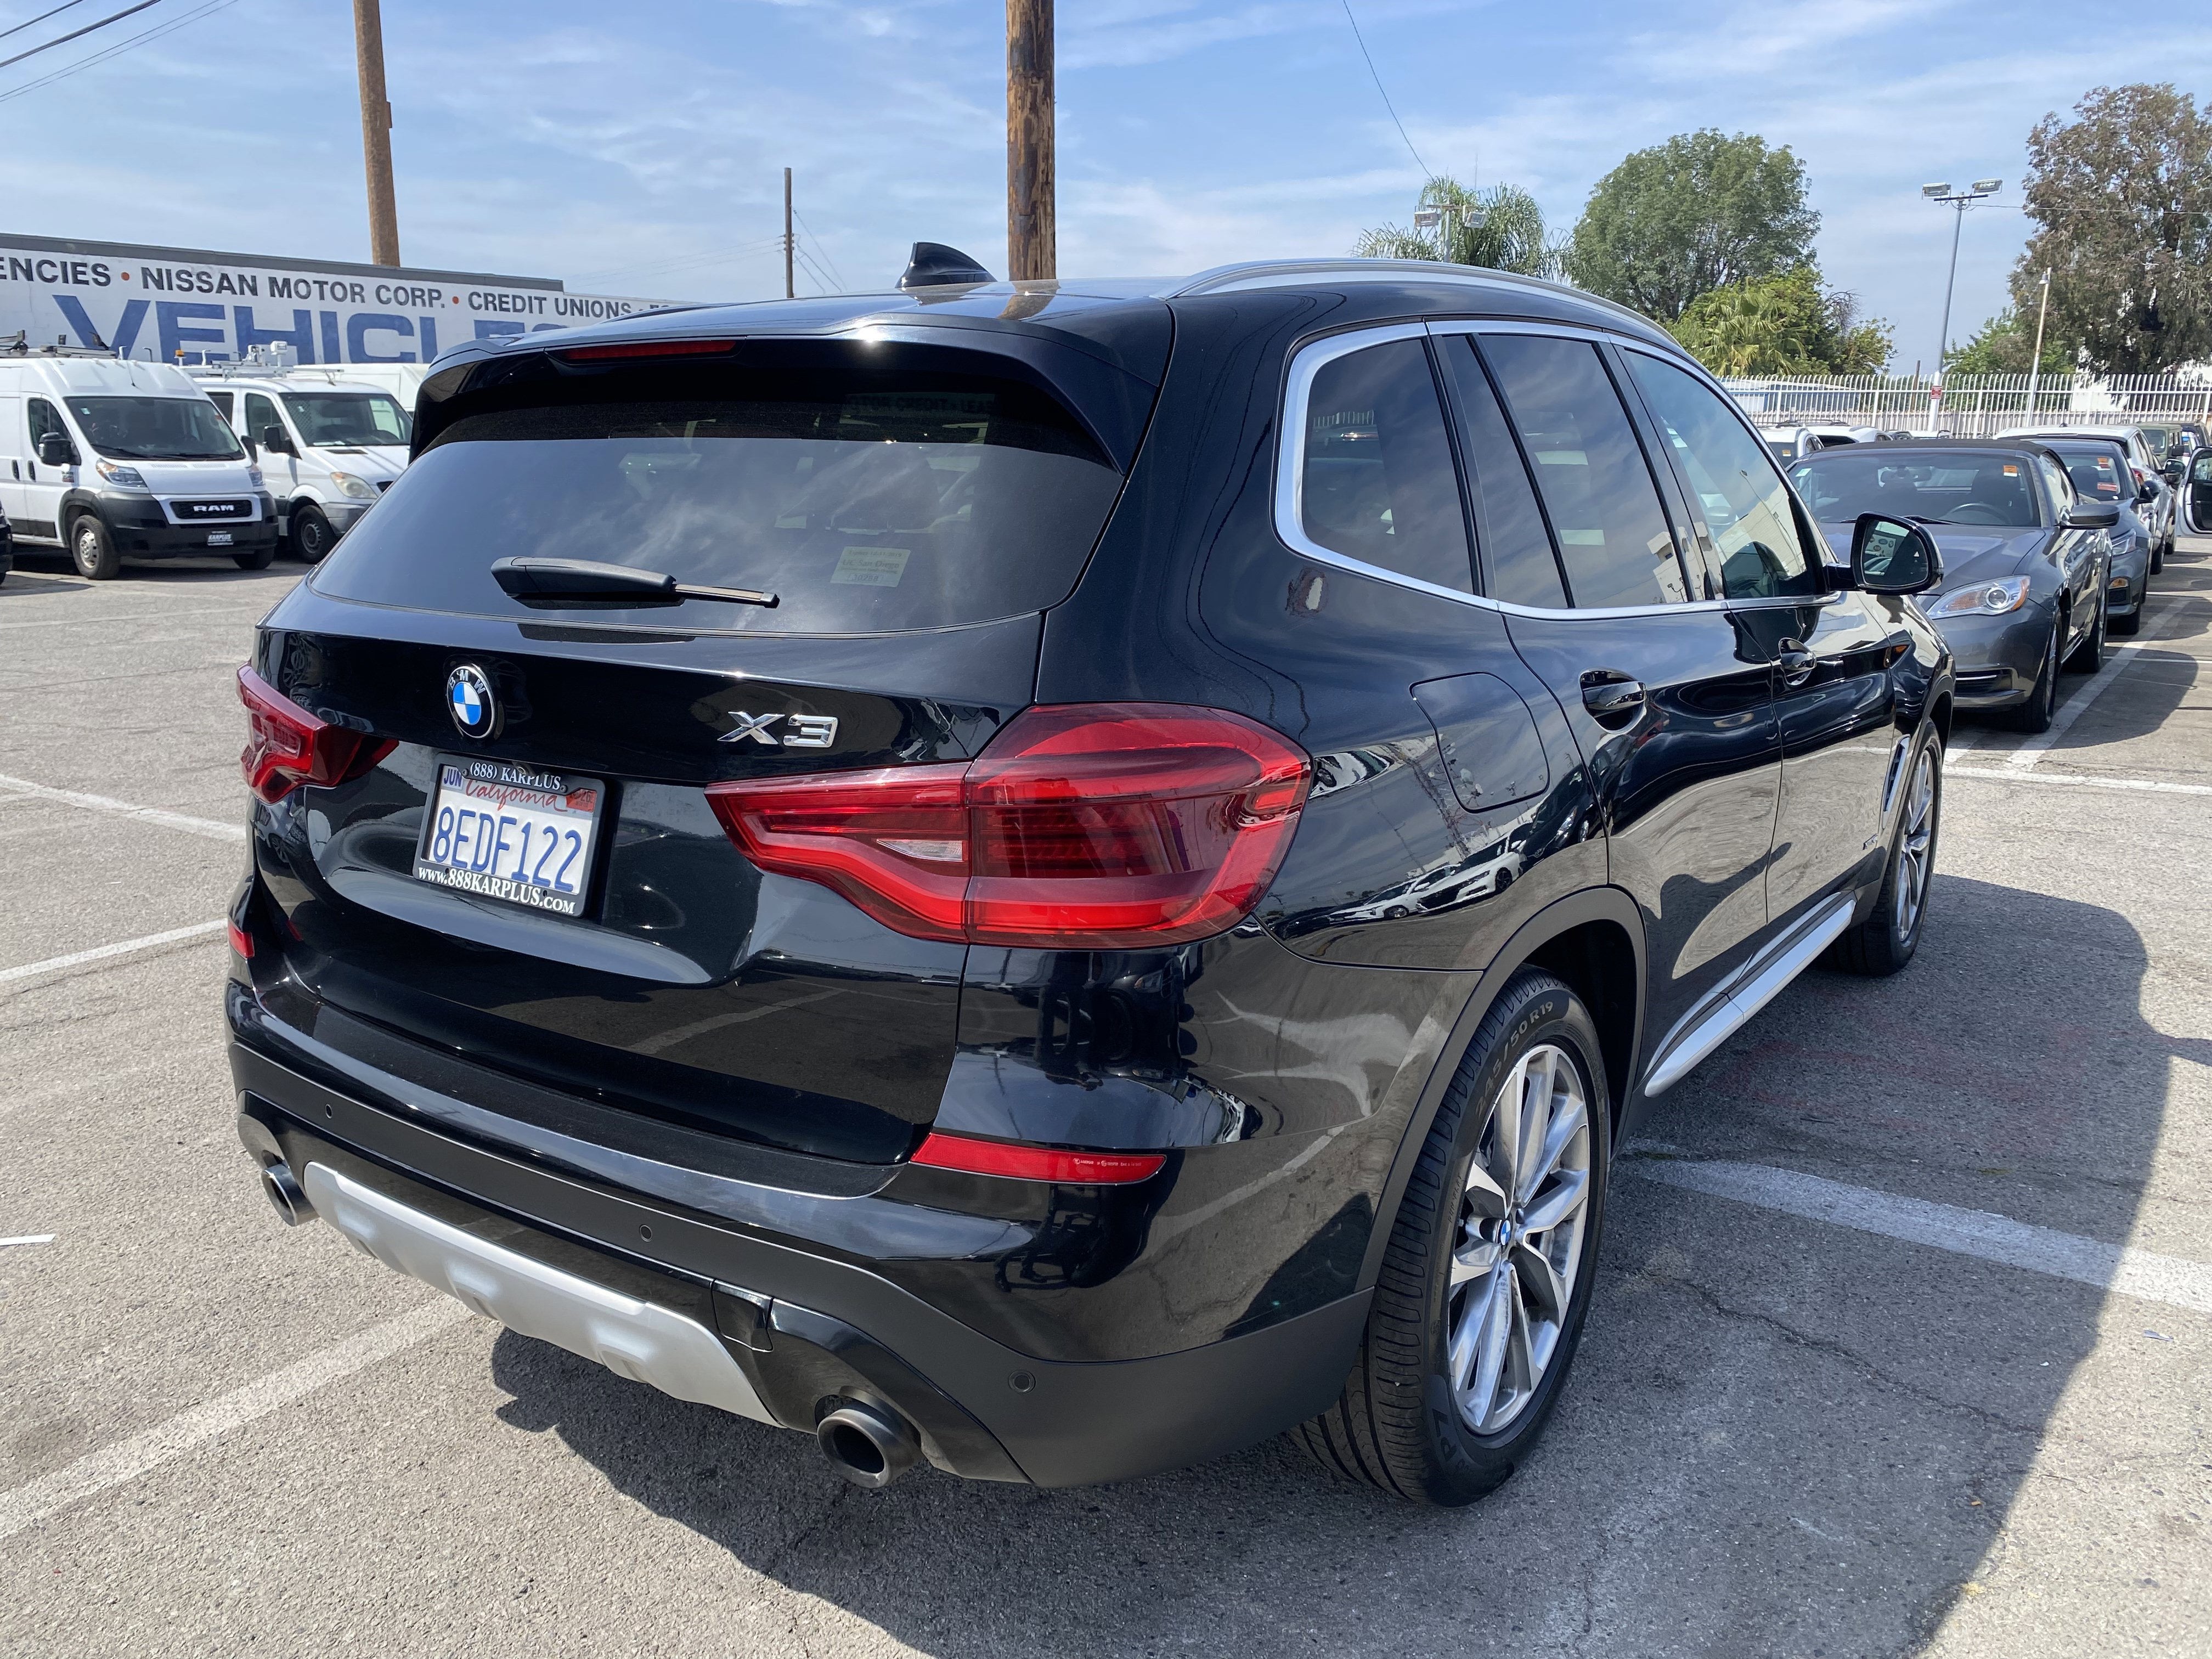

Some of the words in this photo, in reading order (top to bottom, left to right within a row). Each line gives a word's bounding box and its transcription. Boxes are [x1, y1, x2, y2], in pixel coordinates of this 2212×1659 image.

[0, 256, 111, 287] NCIES
[141, 267, 258, 297] NISSAN
[268, 276, 365, 303] MOTOR
[375, 284, 445, 309] CORP.
[468, 291, 546, 314] CREDIT
[554, 297, 631, 319] UNIONS
[52, 295, 569, 365] VEHICL
[875, 561, 900, 569] Diego
[449, 669, 486, 695] BMW
[717, 711, 838, 748] X3
[444, 769, 462, 787] JUN
[470, 762, 498, 779] (888)
[466, 778, 568, 811] California
[433, 806, 582, 893] 8EDF122
